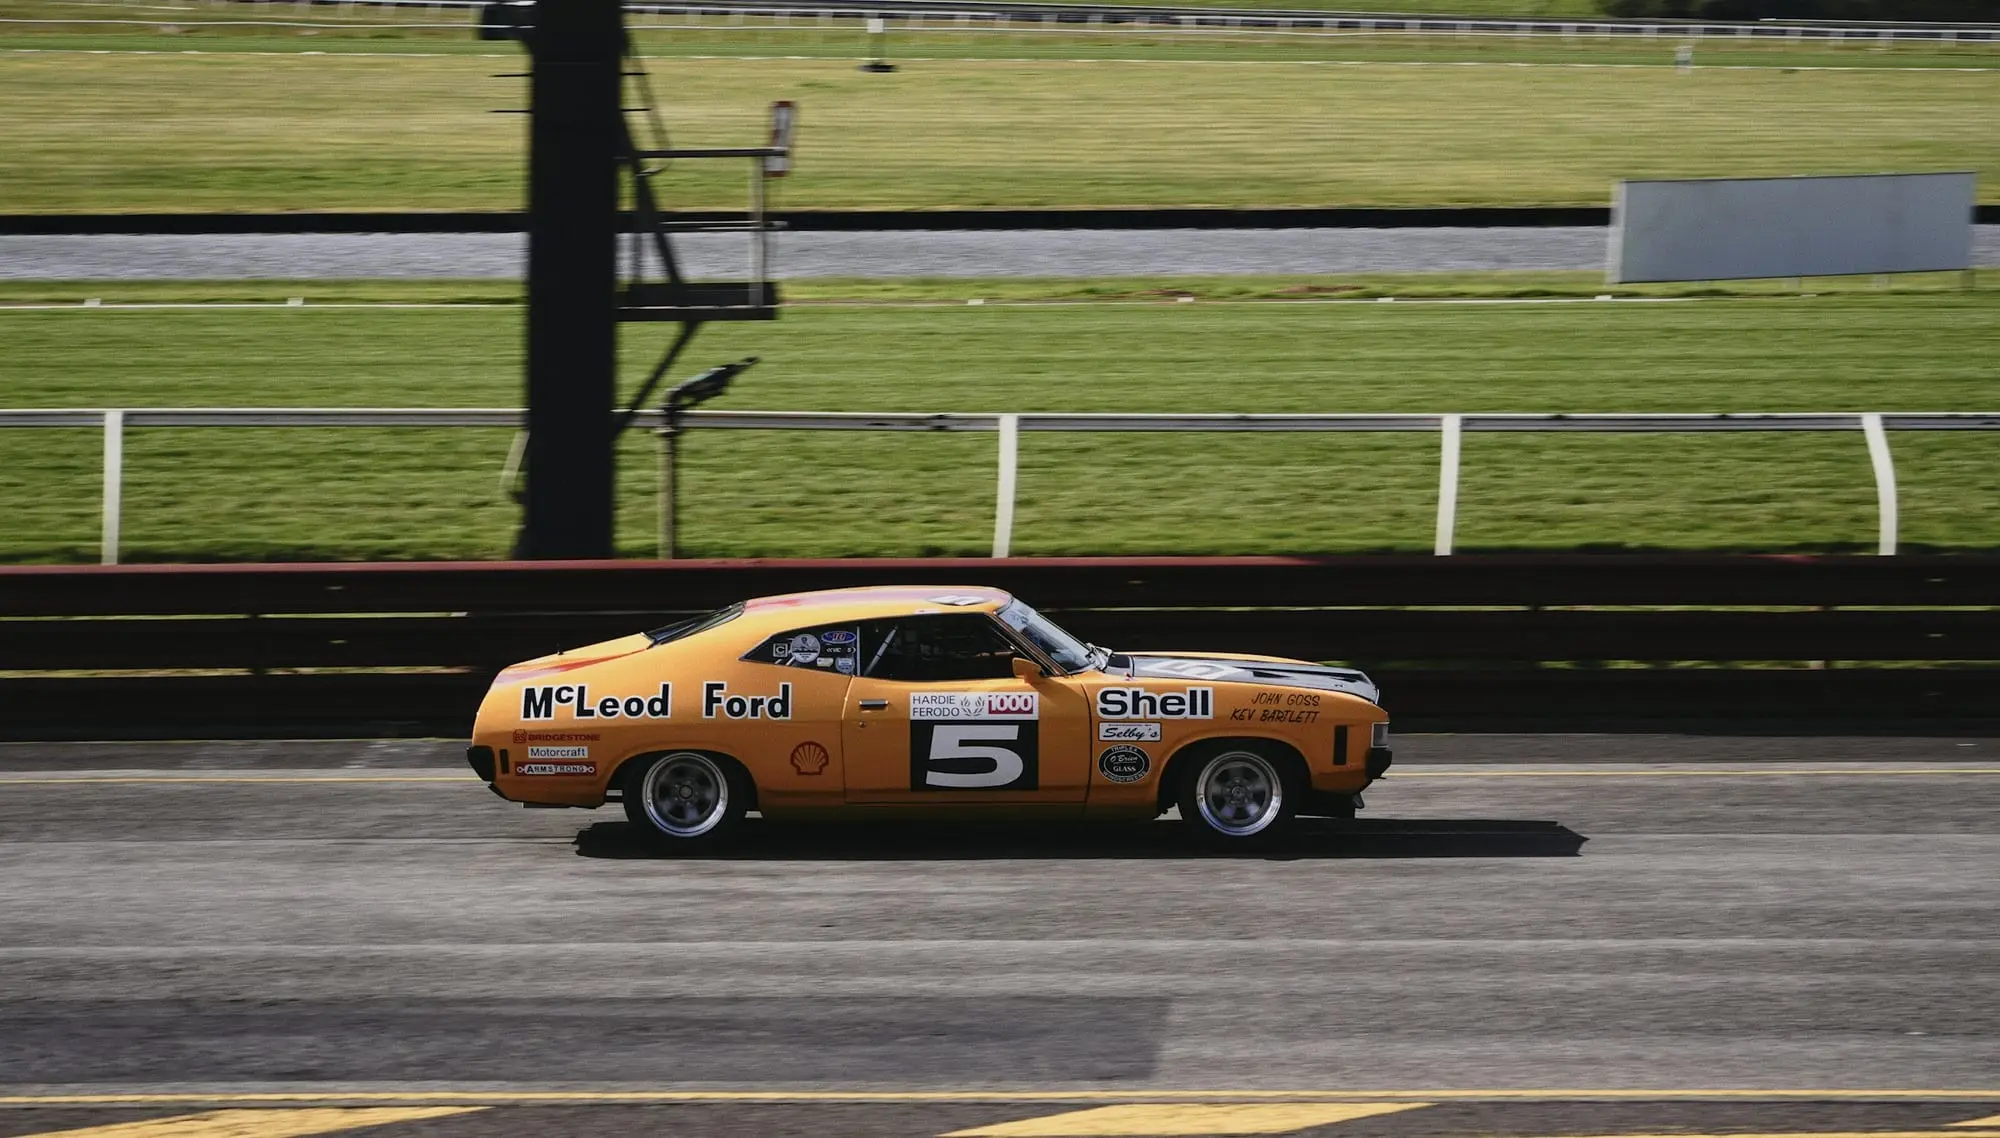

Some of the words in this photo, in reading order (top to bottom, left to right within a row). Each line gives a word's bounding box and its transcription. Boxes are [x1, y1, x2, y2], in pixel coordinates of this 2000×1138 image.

[521, 683, 671, 719] McLeod
[703, 682, 791, 719] Ford
[912, 695, 956, 705] HARDIE
[989, 694, 1033, 712] 1000
[1098, 689, 1210, 717] Shell
[1251, 692, 1283, 705] JOHN
[1287, 694, 1321, 707] GOSS
[912, 707, 960, 717] FERODO
[1230, 708, 1256, 721] KEV
[1260, 709, 1321, 723] BARTLETT
[528, 733, 601, 741] BRIDGESTONE
[1103, 727, 1159, 741] Selby's
[530, 747, 586, 758] Motorcraft
[925, 724, 1024, 788] 5
[526, 764, 585, 774] ARMSTRONG
